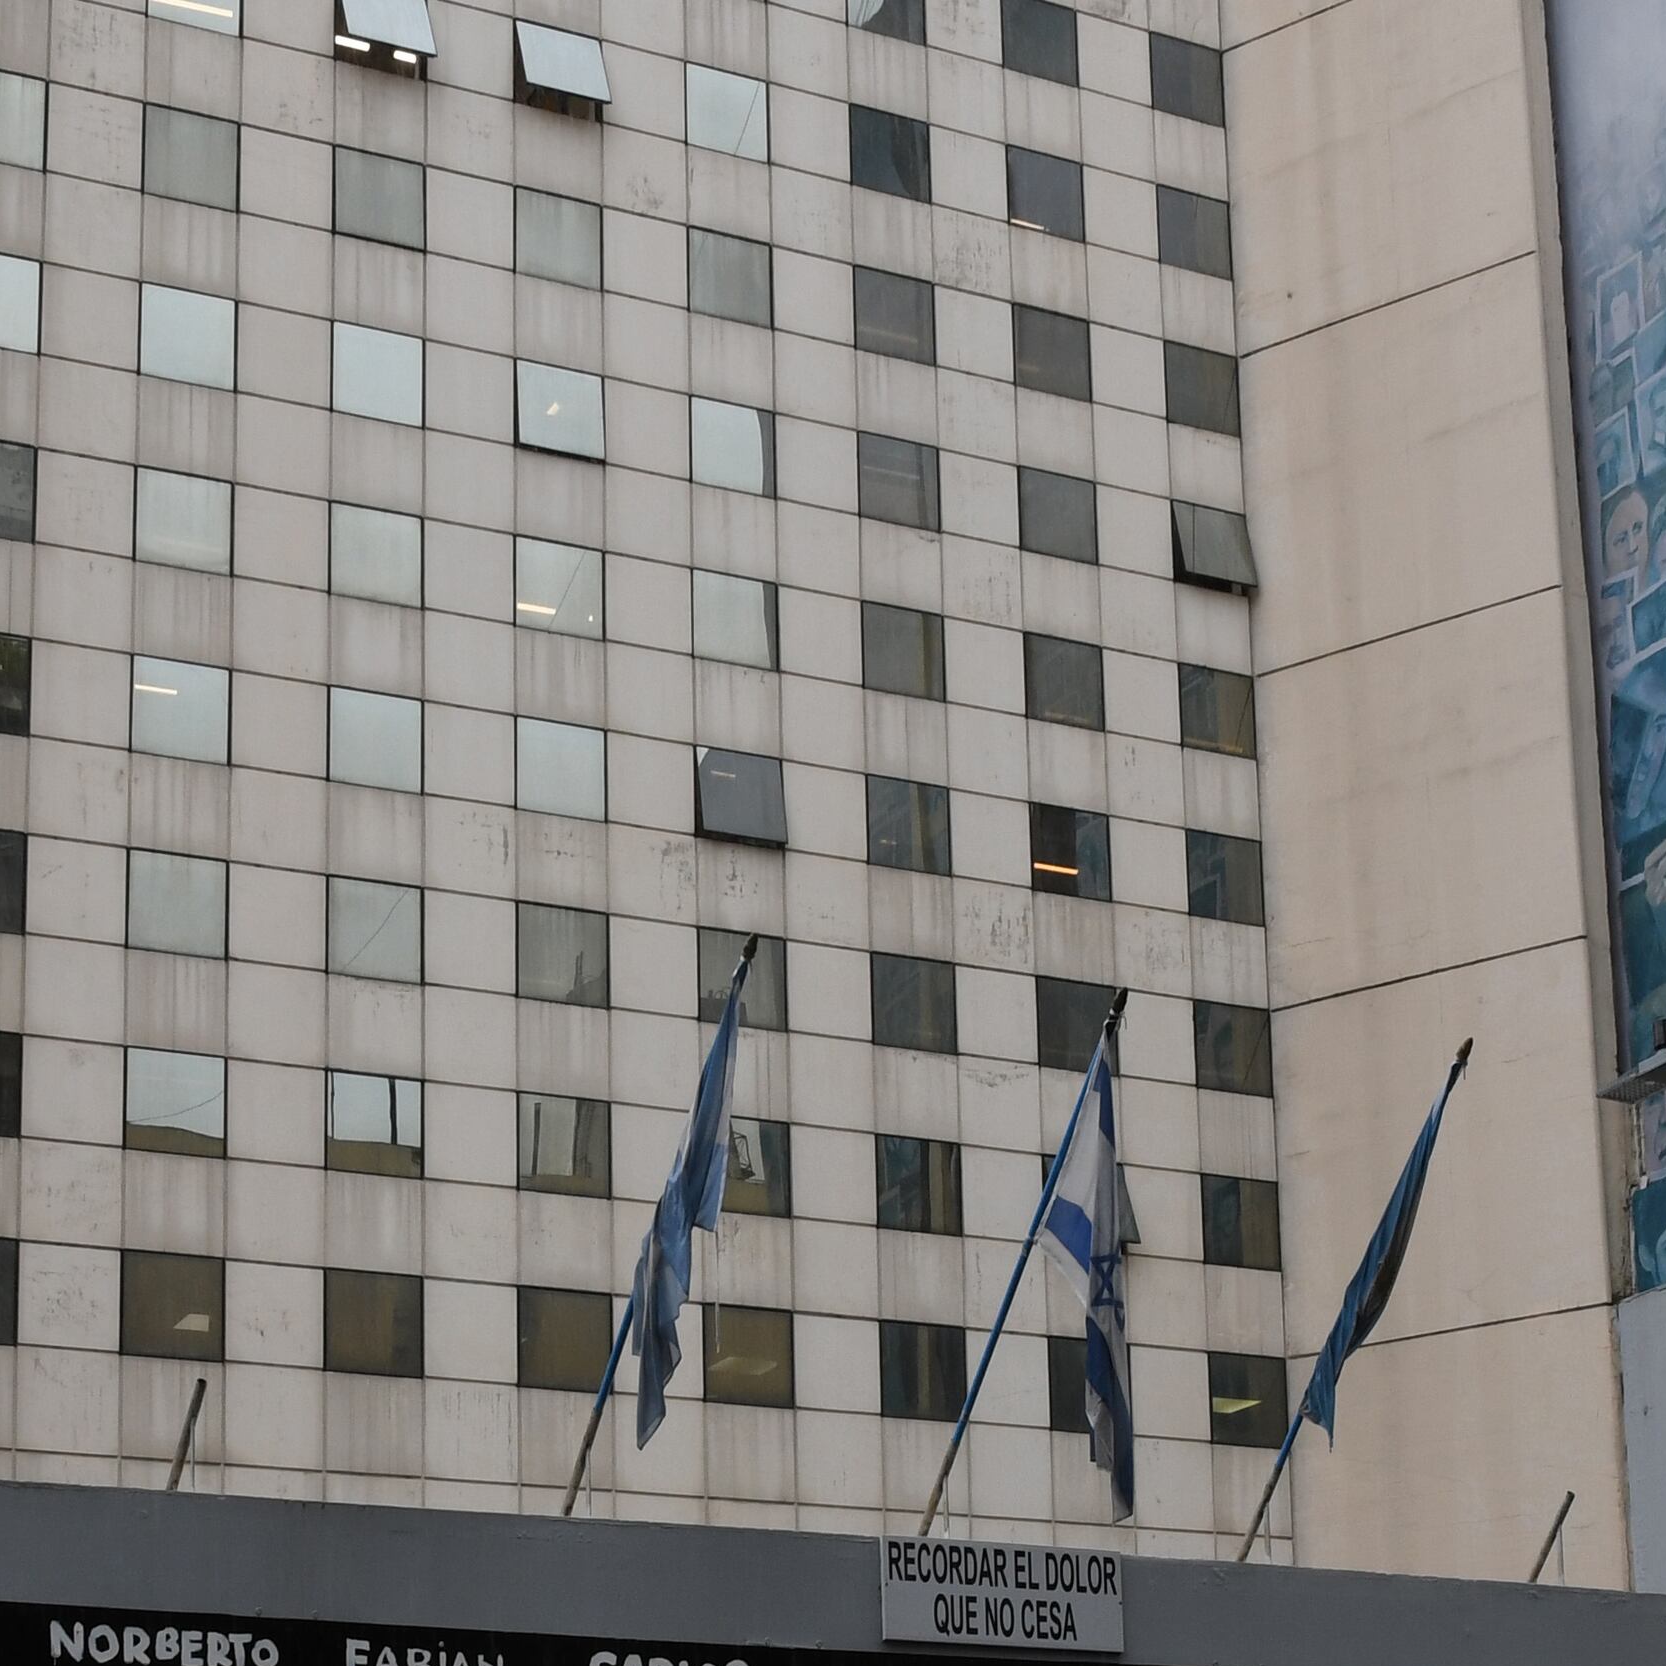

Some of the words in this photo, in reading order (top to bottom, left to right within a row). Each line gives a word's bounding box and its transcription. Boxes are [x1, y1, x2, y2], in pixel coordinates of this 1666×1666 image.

[887, 1541, 1007, 1589] RECORDAR
[1014, 1550, 1039, 1591] EL
[1045, 1552, 1118, 1595] DOLOR
[933, 1593, 978, 1637] QUE
[985, 1597, 1015, 1638] NO
[1021, 1600, 1078, 1642] CESA
